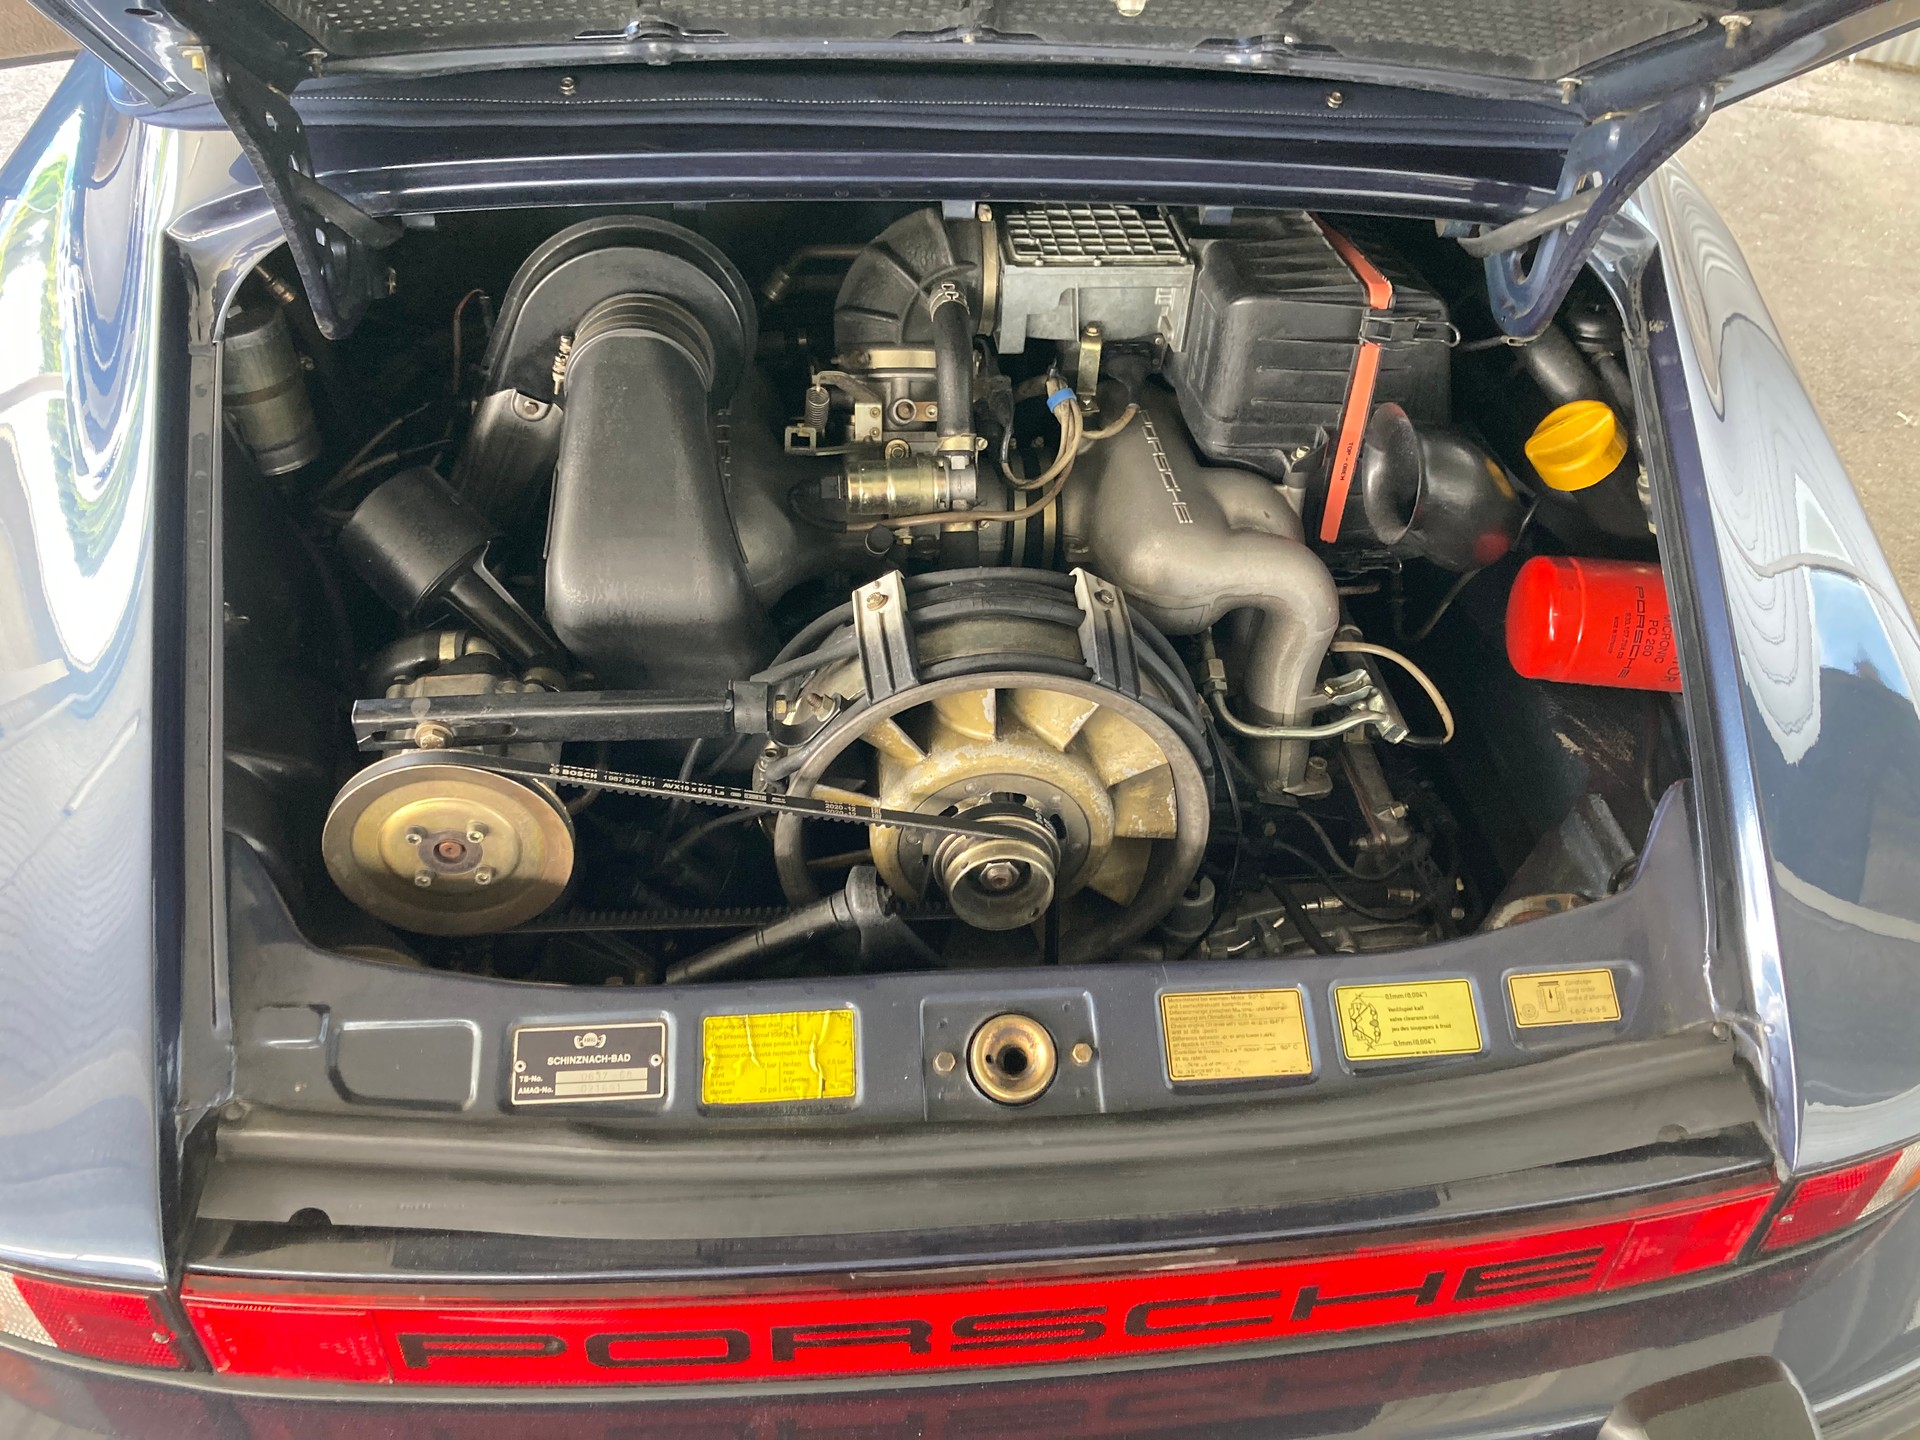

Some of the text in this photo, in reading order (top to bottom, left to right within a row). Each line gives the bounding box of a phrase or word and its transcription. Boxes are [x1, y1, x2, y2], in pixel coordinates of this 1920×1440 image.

[1346, 442, 1354, 455] TOP
[1138, 410, 1194, 524] PORSCHE
[1617, 585, 1646, 679] PORSCHE
[1642, 619, 1659, 657] PC 260
[562, 769, 598, 779] BOSCH
[662, 782, 690, 791] AVX10
[547, 1053, 631, 1066] SCHINZNACH-BAD
[518, 1085, 554, 1095] AMAG-No.
[400, 1246, 1605, 1368] PORSCHE
